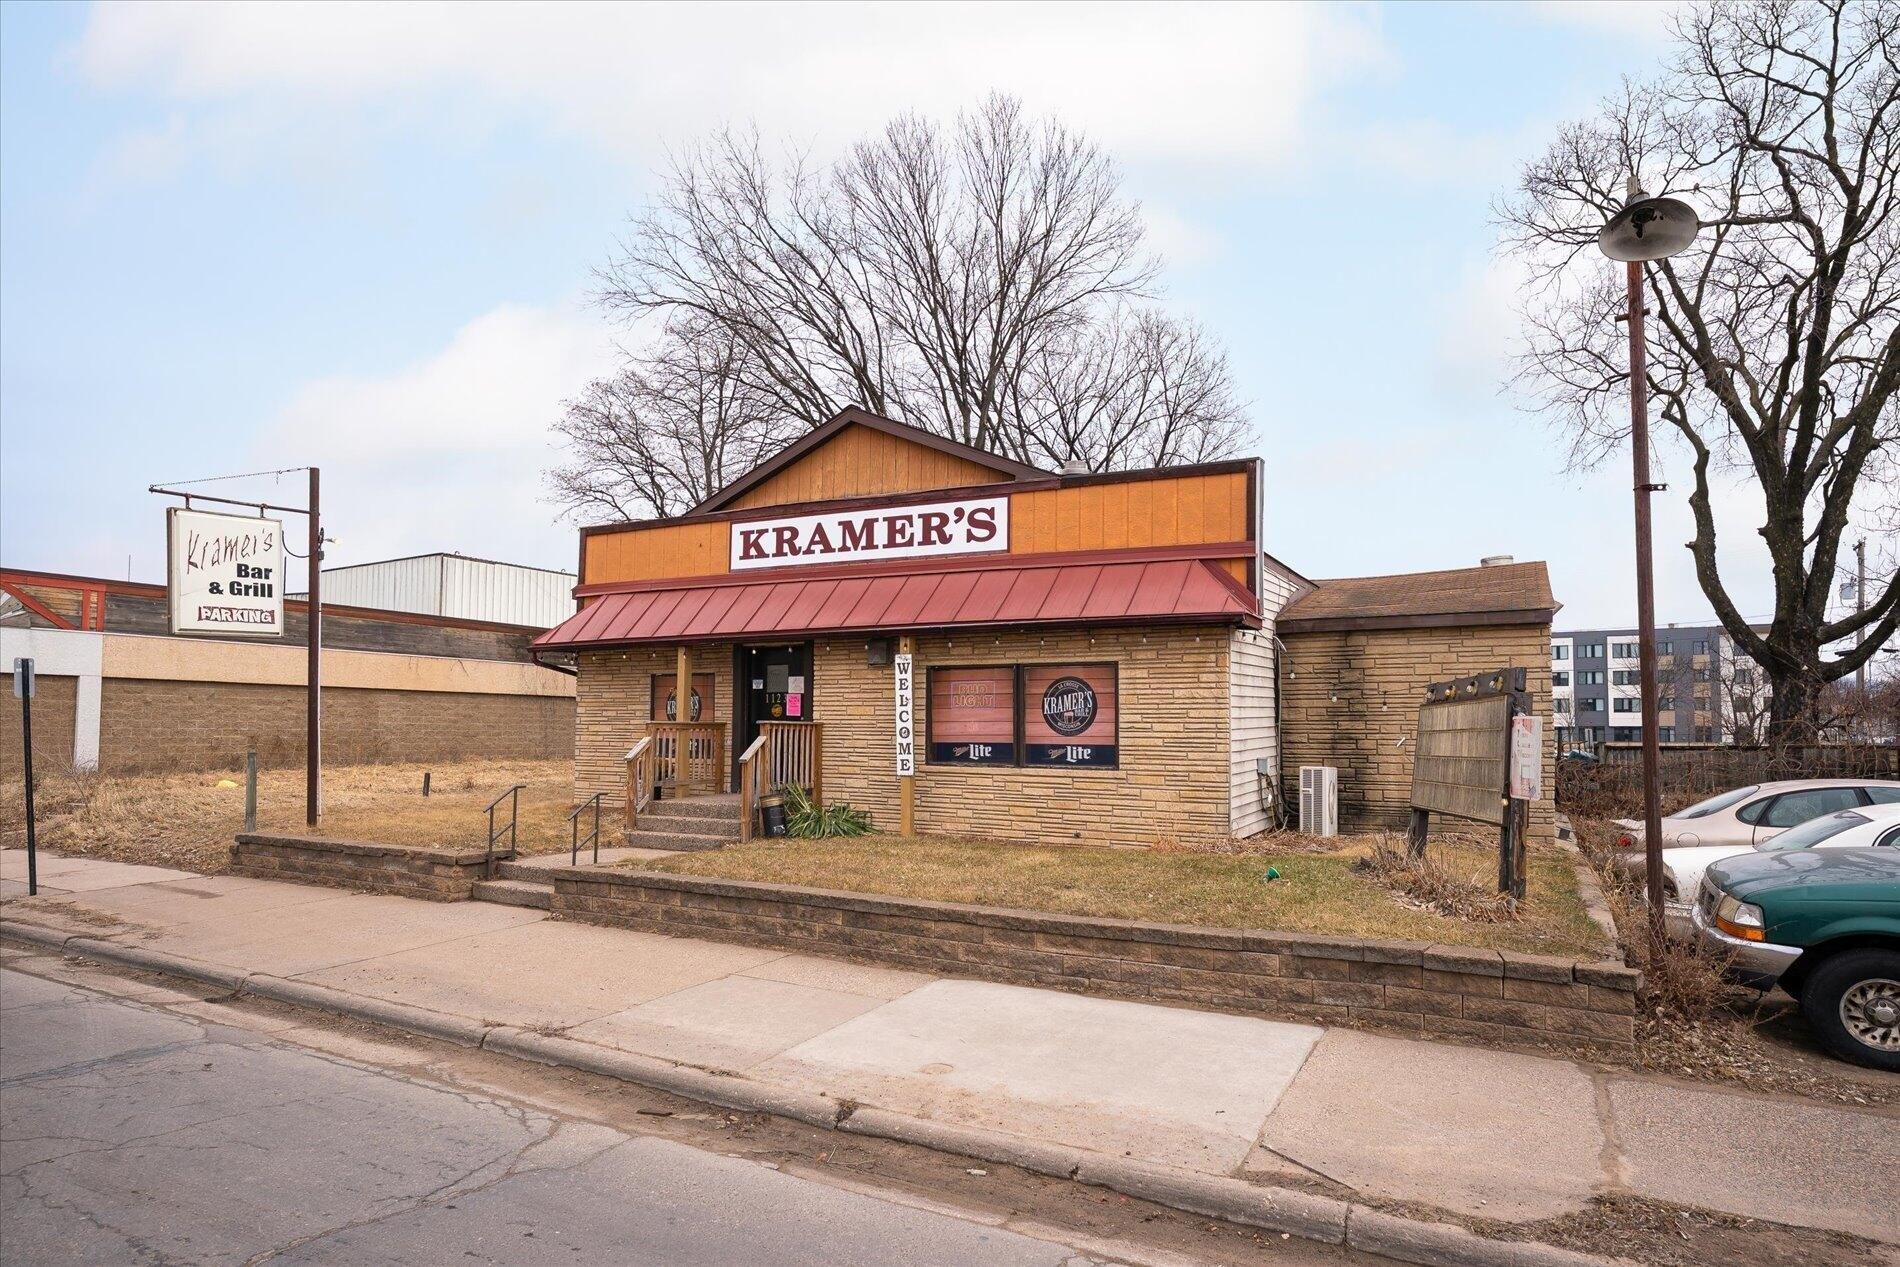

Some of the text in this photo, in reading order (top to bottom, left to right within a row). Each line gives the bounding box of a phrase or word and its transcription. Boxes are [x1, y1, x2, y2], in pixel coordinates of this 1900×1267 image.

[738, 506, 998, 561] KRAMER'S
[187, 528, 273, 575] Kramer's
[236, 563, 273, 580] Bar
[208, 580, 273, 598] & Grill
[199, 606, 273, 624] PARKING
[953, 695, 994, 707] LIGHT
[1043, 690, 1093, 715] KRAMER'S
[896, 662, 912, 772] WELCOME
[968, 743, 992, 760] Lite
[1065, 745, 1091, 763] Lite
